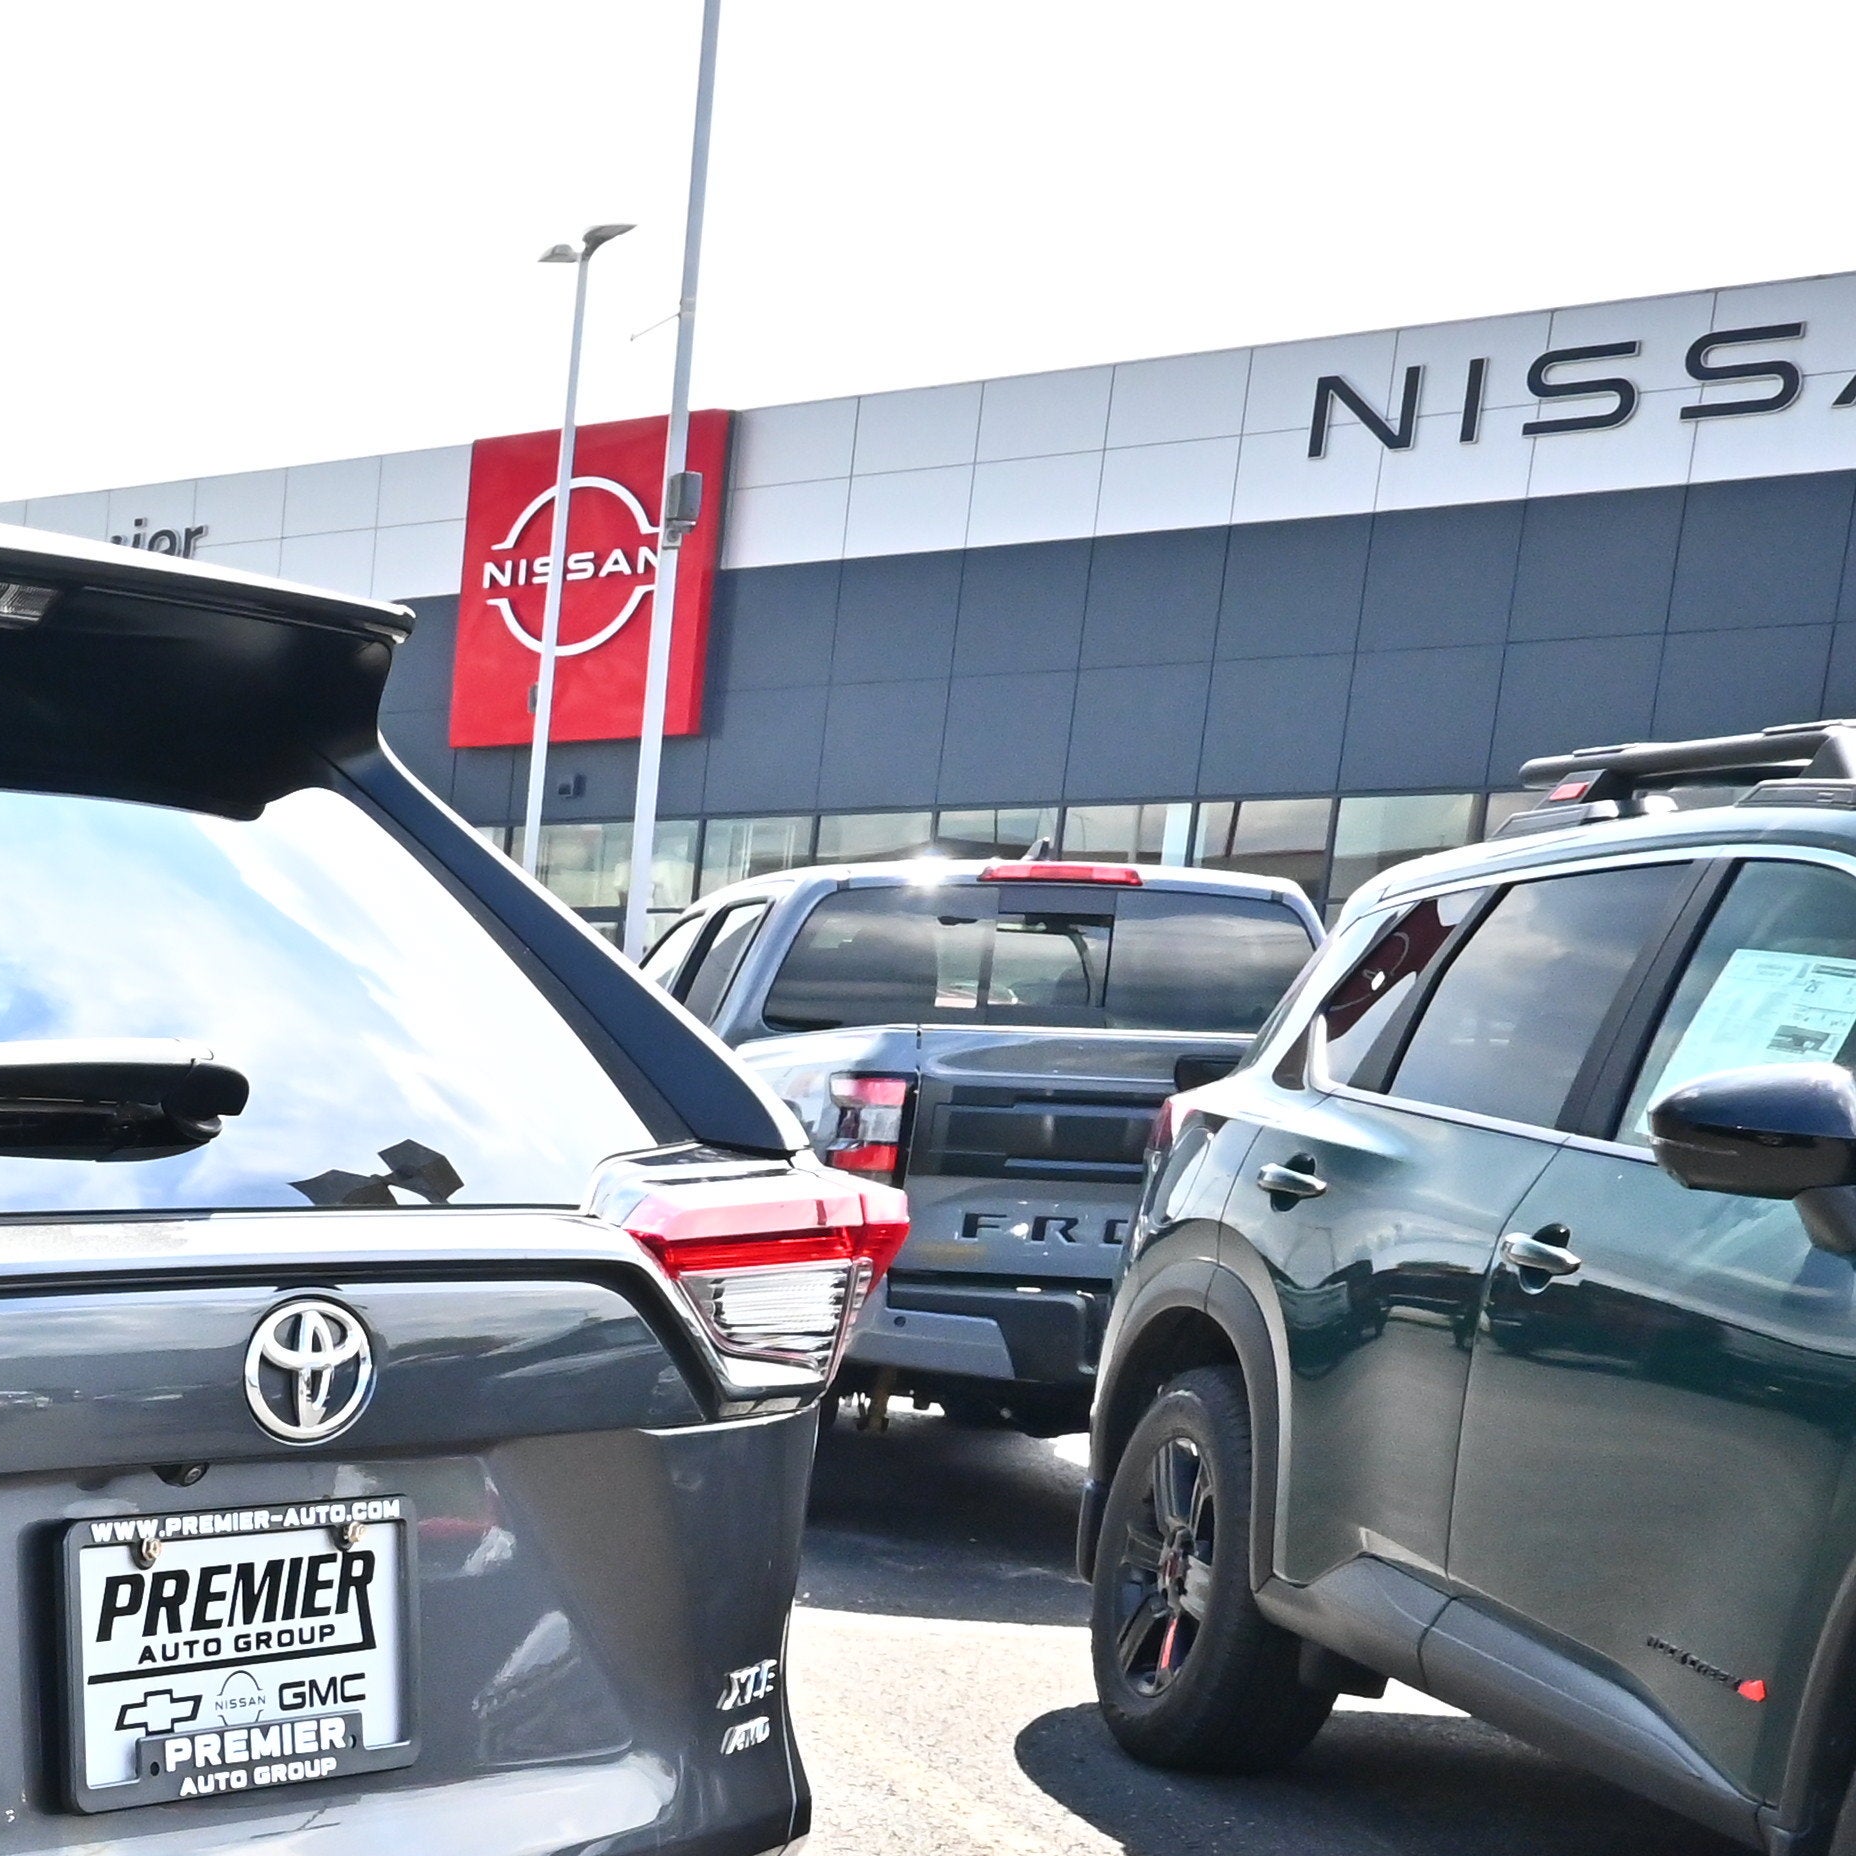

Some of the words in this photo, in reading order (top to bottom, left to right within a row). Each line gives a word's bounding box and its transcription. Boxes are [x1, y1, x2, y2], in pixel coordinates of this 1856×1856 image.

[1307, 320, 1856, 460] NISS
[110, 517, 208, 560] ior
[90, 1499, 400, 1543] WWW.PREMIER-AUTO.COM
[96, 1550, 377, 1646] PREMIER
[138, 1637, 222, 1665] AUTO
[234, 1624, 336, 1653] GROUP
[214, 1695, 267, 1711] NISSAN
[278, 1672, 366, 1711] GMC
[165, 1716, 346, 1773] PREMIER
[180, 1769, 248, 1797] AUTO
[253, 1757, 337, 1785] GROUP
